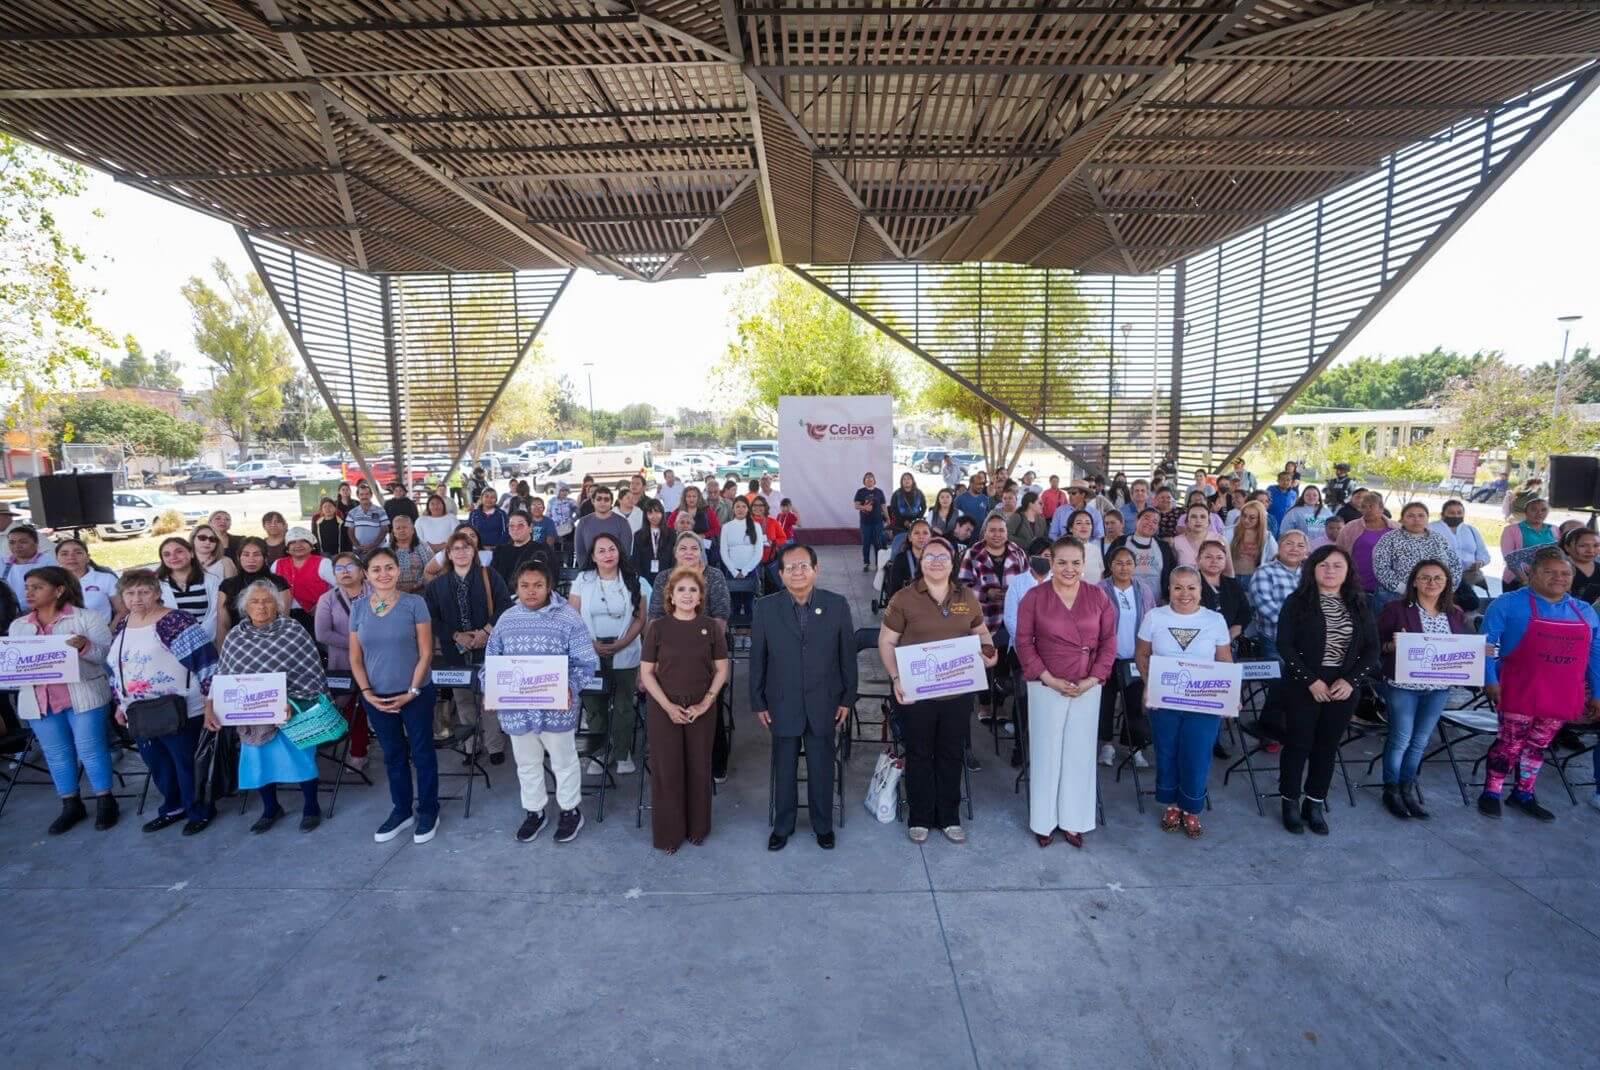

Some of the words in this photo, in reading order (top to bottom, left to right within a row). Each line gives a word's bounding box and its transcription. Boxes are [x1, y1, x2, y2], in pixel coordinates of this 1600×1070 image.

[829, 423, 874, 437] Celaya
[17, 651, 68, 664] MUJERES
[1432, 651, 1476, 662] MUJERES
[936, 654, 975, 672] MUJERES
[521, 673, 560, 685] MUJERES
[1186, 680, 1231, 688] MUJERES
